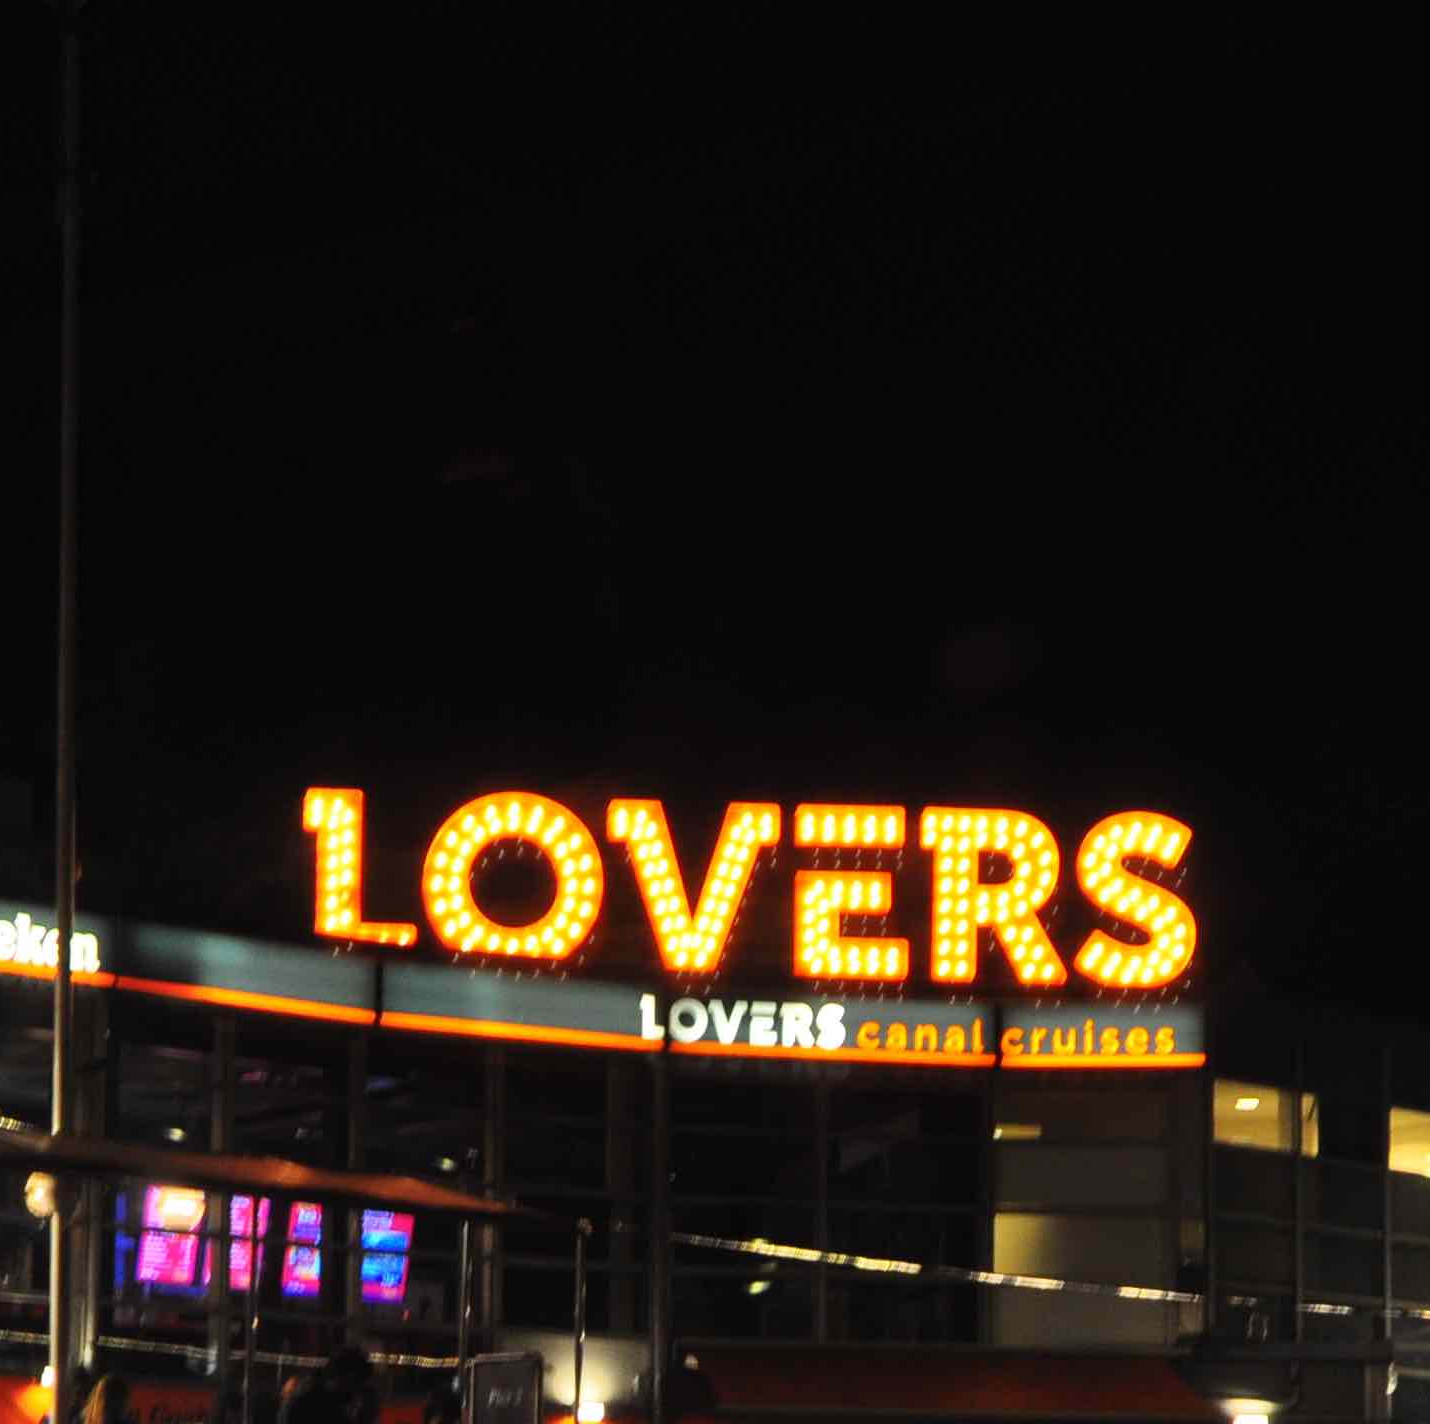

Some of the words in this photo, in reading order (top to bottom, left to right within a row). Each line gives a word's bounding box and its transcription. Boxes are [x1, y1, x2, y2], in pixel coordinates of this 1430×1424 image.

[302, 787, 1198, 987] LOVERS
[640, 993, 846, 1051] LOVERS
[856, 1017, 984, 1055] canal
[1001, 1017, 1175, 1057] cruises
